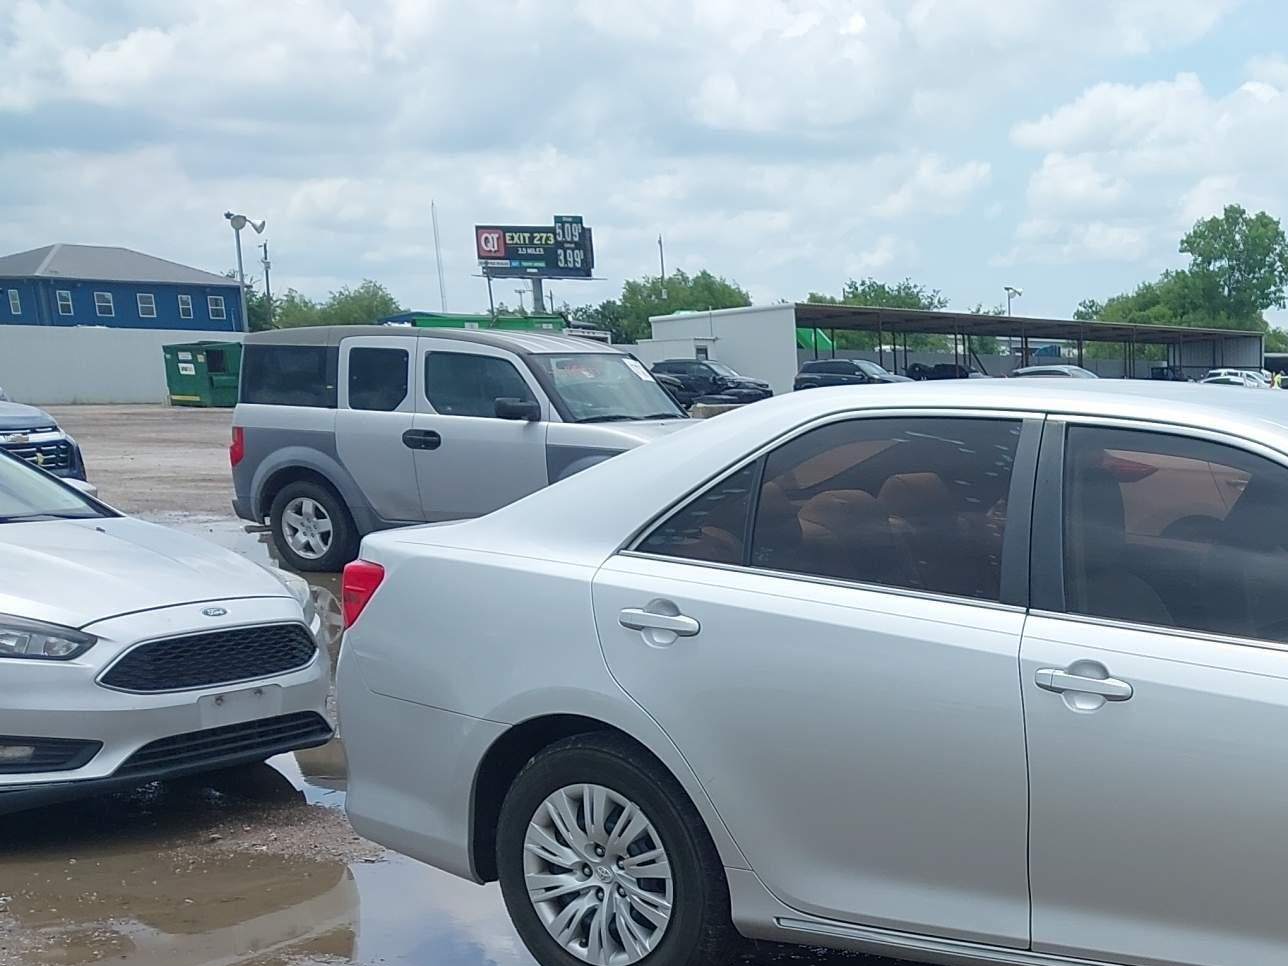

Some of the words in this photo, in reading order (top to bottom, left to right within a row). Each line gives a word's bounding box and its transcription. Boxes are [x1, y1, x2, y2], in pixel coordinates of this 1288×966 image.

[481, 233, 499, 251] QT
[505, 233, 530, 244] EXIT
[533, 233, 555, 245] 273
